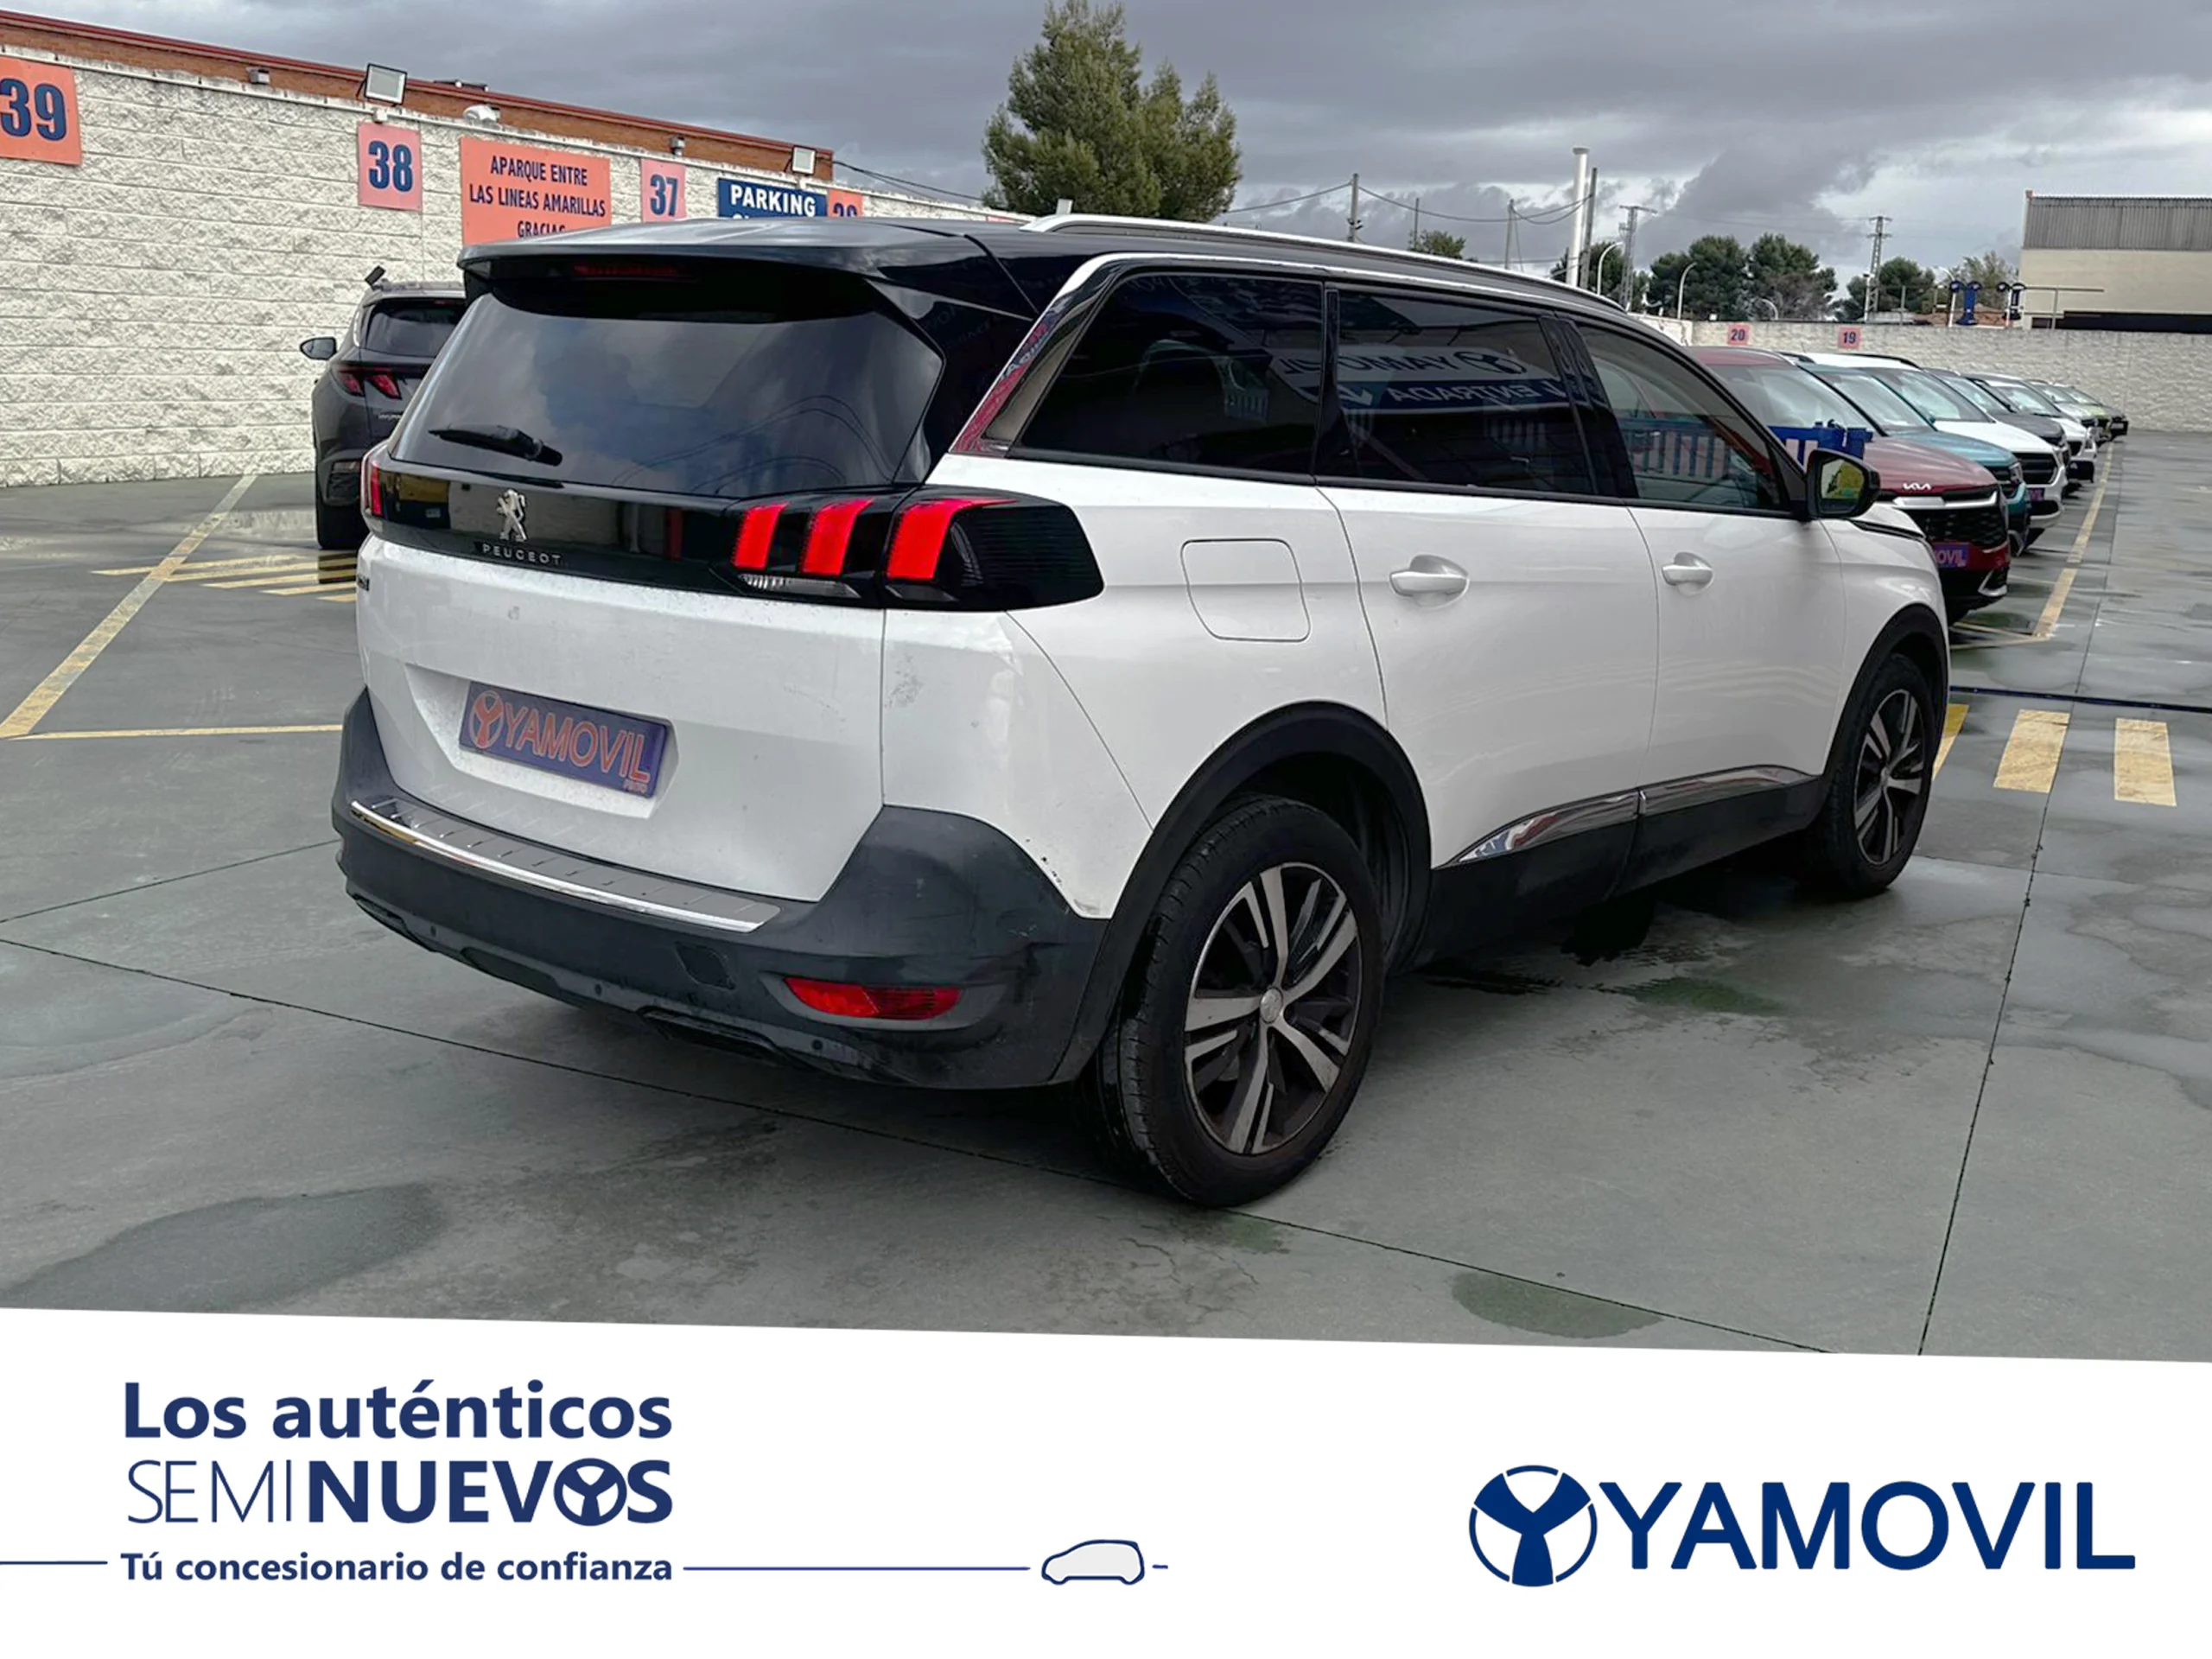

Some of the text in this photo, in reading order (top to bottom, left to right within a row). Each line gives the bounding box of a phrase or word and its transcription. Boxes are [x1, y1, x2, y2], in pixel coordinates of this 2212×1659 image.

[0, 78, 67, 141] 39
[368, 141, 413, 193] 38
[491, 156, 588, 187] APARQUE ENTRE
[469, 183, 606, 217] LAS LINEAS AMARILLAS
[650, 174, 678, 217] 37
[730, 184, 816, 217] PARKING
[1730, 328, 1745, 341] 20
[1842, 332, 1856, 344] 19
[482, 543, 562, 565] PEUGEOT
[504, 701, 651, 783] YAMOVIL
